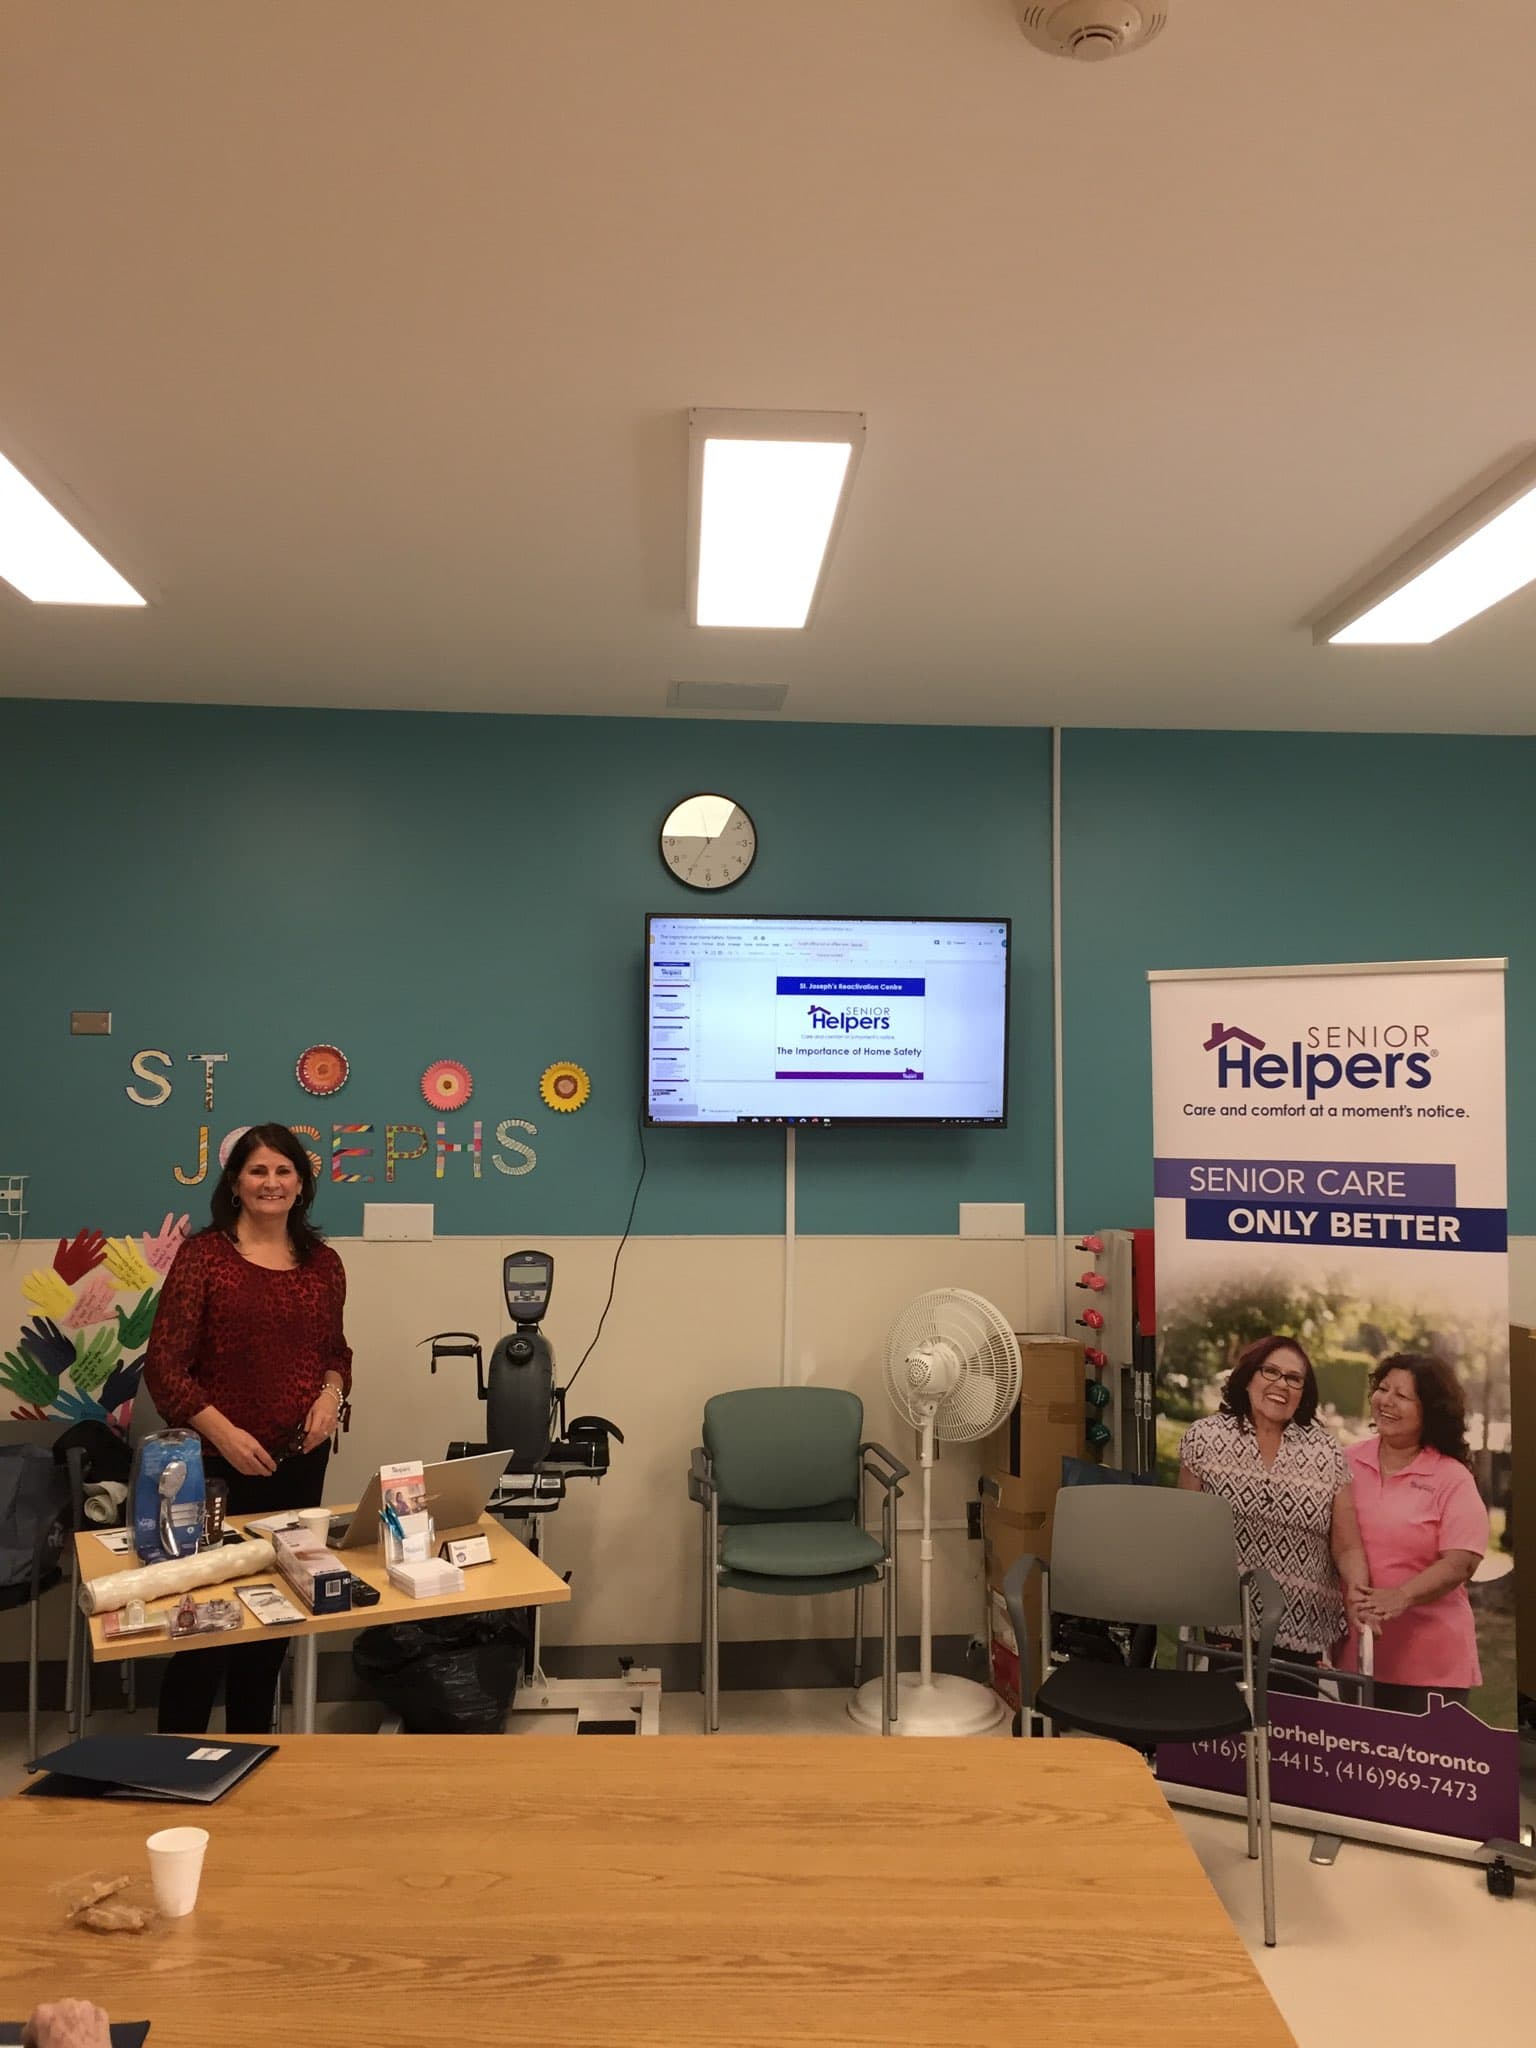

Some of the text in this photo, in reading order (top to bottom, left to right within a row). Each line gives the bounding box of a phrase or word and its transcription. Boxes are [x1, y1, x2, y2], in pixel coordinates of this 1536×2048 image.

[736, 821, 743, 830] 2
[669, 838, 676, 847] 9
[740, 839, 748, 848] 3
[673, 855, 680, 864] 8
[736, 855, 742, 864] 4
[687, 867, 693, 876] 7
[723, 868, 729, 878] 5
[705, 872, 711, 882] 6
[846, 1006, 890, 1016] SENIOR
[812, 1012, 890, 1033] Helpers
[1306, 1024, 1430, 1048] SENIOR
[777, 1047, 922, 1058] The Importance of Home Safety
[126, 1048, 229, 1112] ST
[1183, 1104, 1471, 1118] Care and comfort at a moment's notice.
[1190, 1166, 1407, 1198] SENIOR CARE
[1227, 1208, 1461, 1242] ONLY BETTER
[1267, 1720, 1491, 1776] iorhelpers.ca/toronto
[1191, 1738, 1478, 1803] (416)9-4415, (416)969-7473
